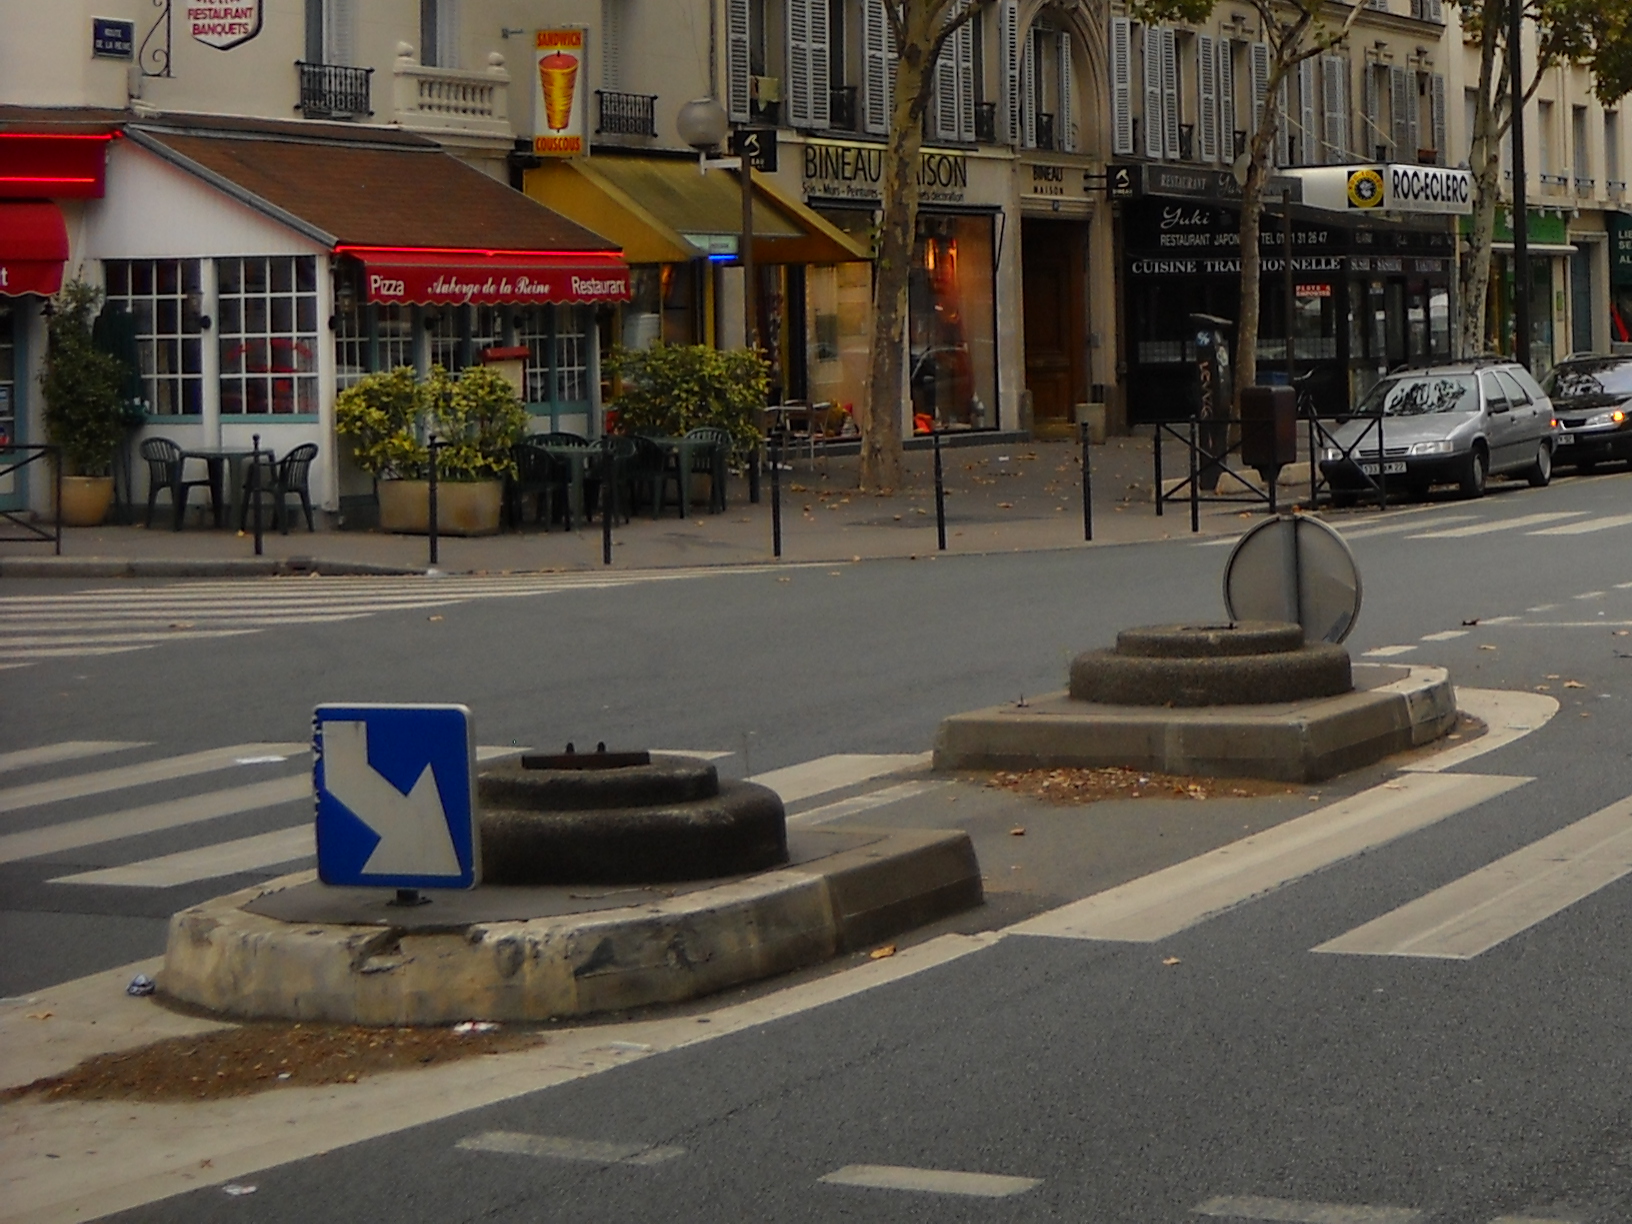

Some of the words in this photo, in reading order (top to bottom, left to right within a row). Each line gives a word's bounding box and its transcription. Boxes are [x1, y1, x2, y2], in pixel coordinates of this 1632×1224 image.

[187, 7, 254, 20] RESTAURANT
[191, 23, 250, 37] BANQUETS
[537, 32, 582, 47] SANDWICH
[535, 137, 580, 152] COUSCOUS
[805, 145, 882, 183] BINEAU
[1033, 185, 1064, 196] MAISON
[1393, 169, 1468, 204] ROC-ECLERC
[1160, 206, 1210, 229] Yuki
[1160, 234, 1210, 247] RESTAURANT
[1214, 233, 1240, 246] JAPON
[1262, 233, 1275, 244] TEL
[1132, 259, 1197, 274] CUISINE
[370, 274, 405, 296] Pizza
[427, 275, 481, 302] Auberge
[482, 276, 496, 295] de
[500, 276, 513, 294] la
[515, 276, 551, 295] Reine
[1394, 463, 1404, 472] 22
